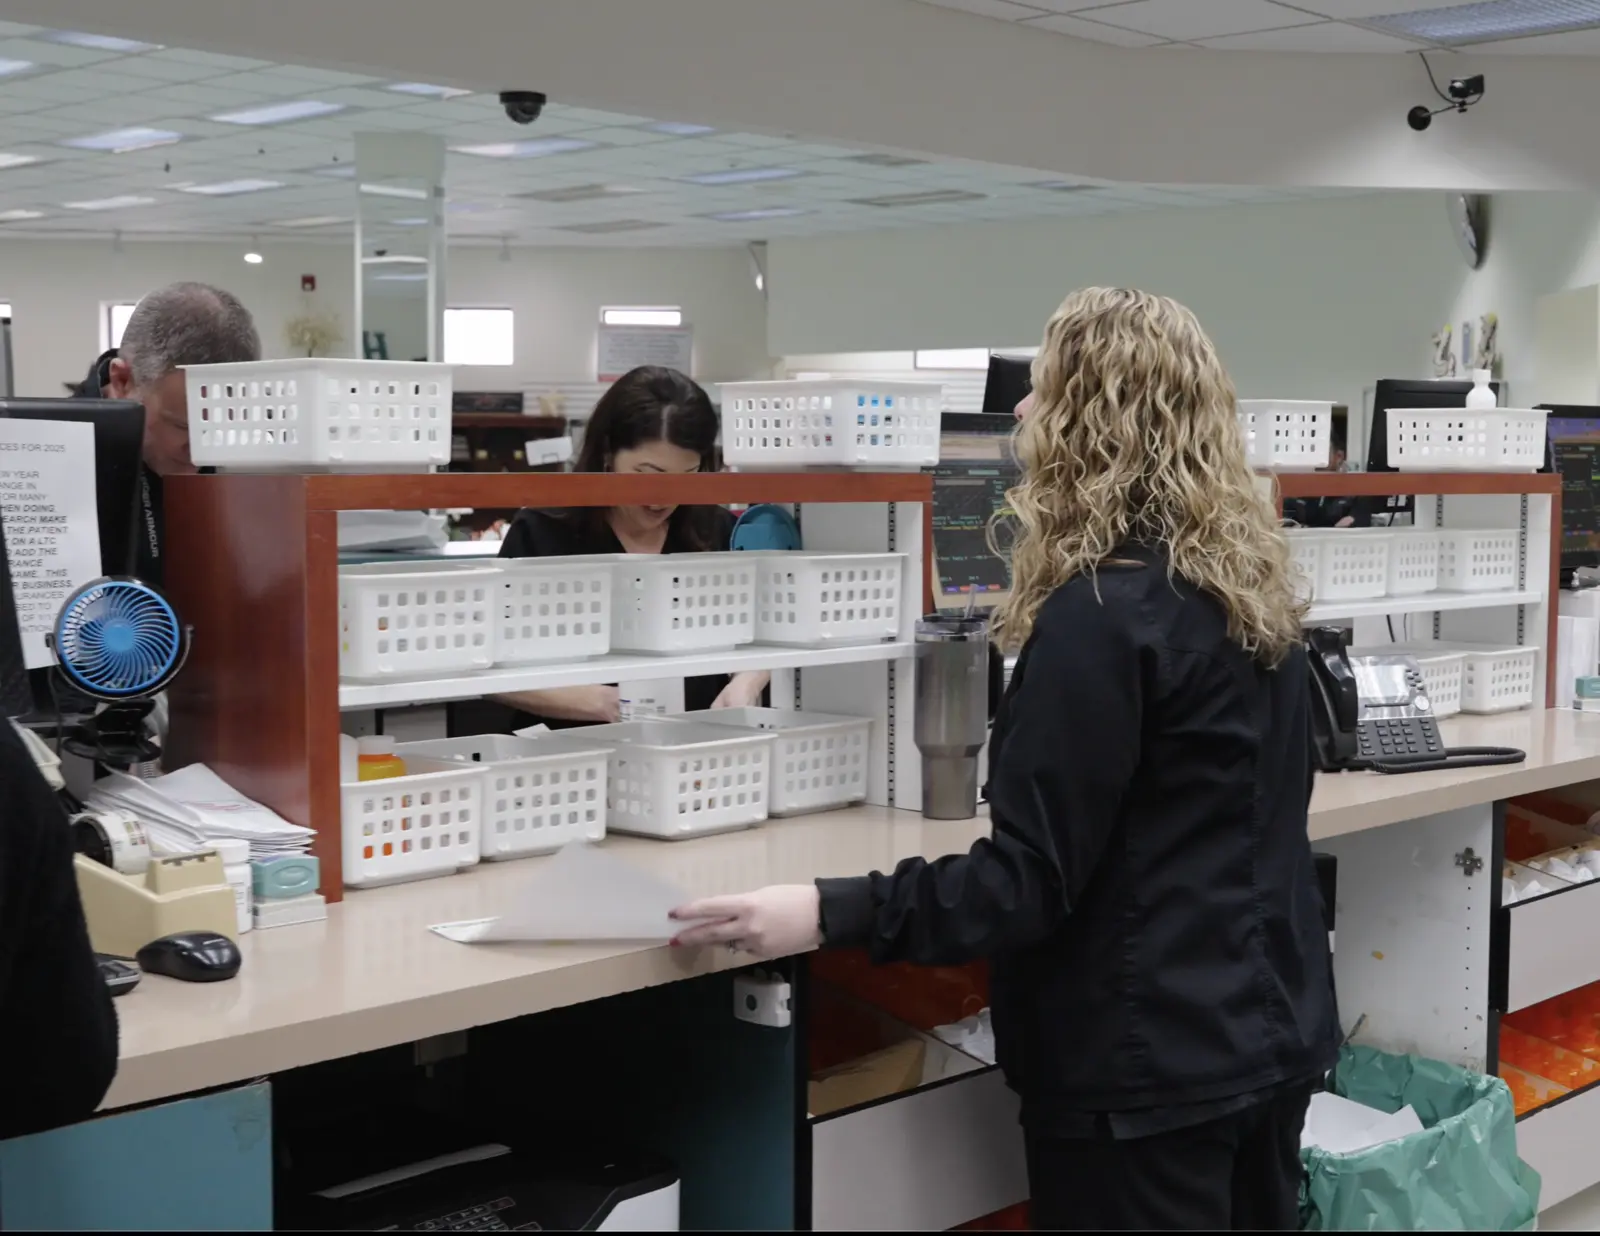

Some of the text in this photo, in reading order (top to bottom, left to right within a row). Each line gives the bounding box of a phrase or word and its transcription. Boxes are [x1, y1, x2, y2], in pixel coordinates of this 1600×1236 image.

[22, 443, 42, 451] FOR
[44, 444, 66, 452] 2025
[13, 470, 40, 478] YEAR
[27, 482, 37, 490] IN
[19, 493, 48, 501] MANY
[39, 515, 67, 523] MAKE
[7, 526, 69, 534] THE PATIENT
[144, 509, 159, 558] ARMOUR
[12, 537, 26, 545] ON
[29, 537, 36, 545] A
[38, 536, 57, 545] LTC
[15, 548, 36, 556] ADD
[38, 547, 58, 556] THE
[46, 568, 68, 577] THIS
